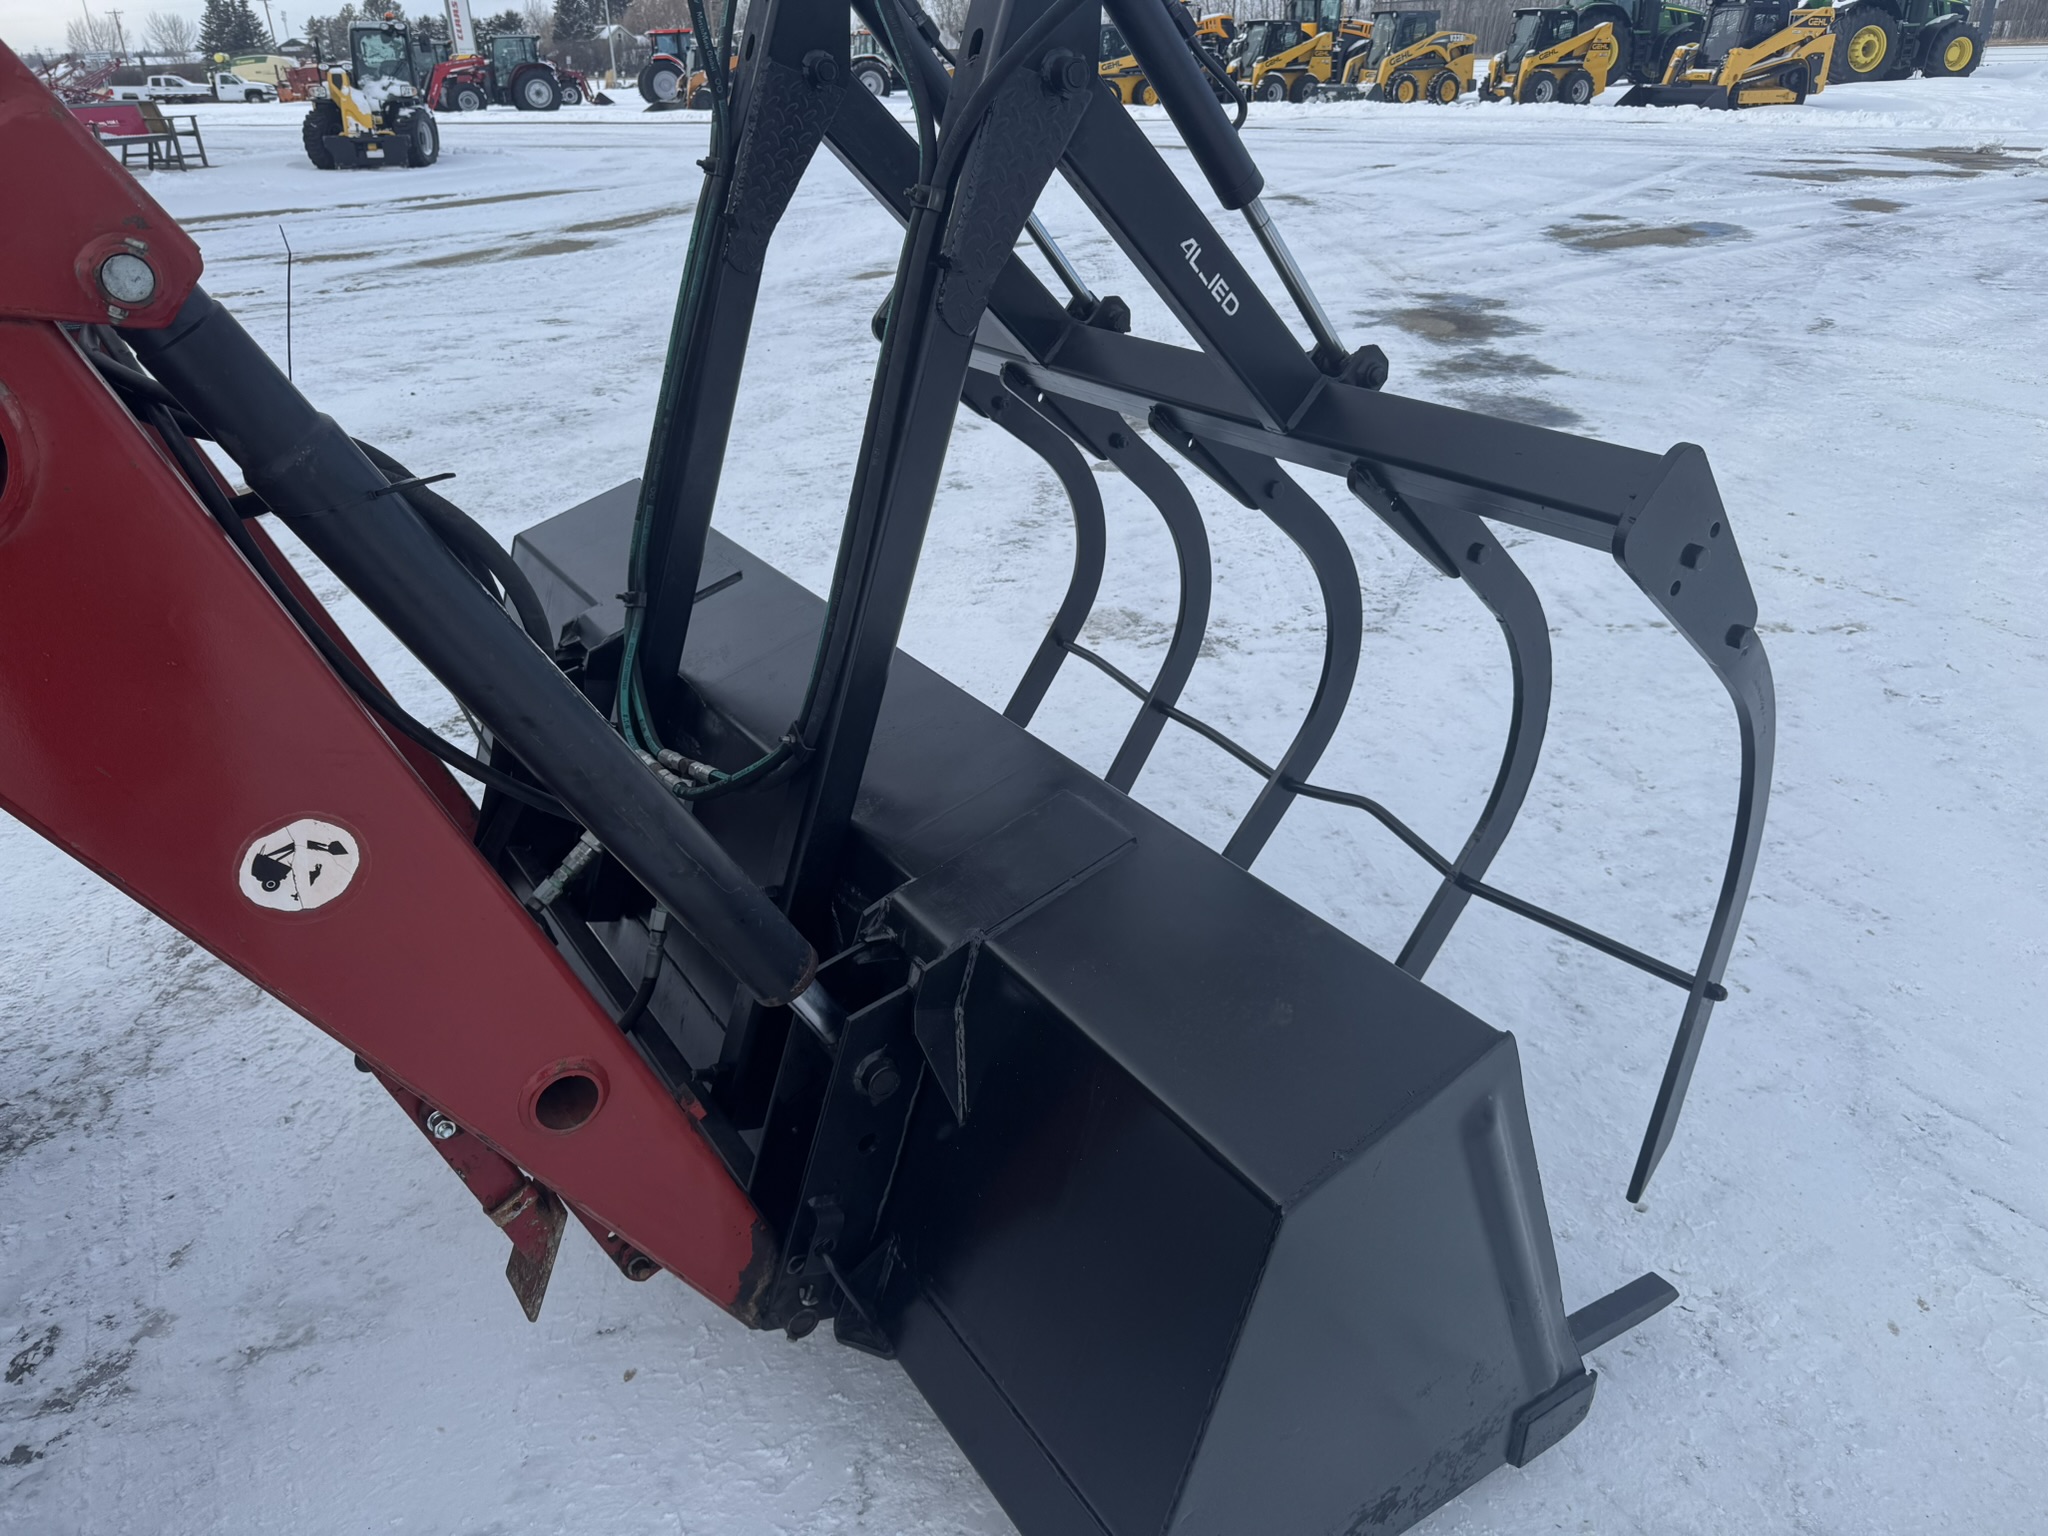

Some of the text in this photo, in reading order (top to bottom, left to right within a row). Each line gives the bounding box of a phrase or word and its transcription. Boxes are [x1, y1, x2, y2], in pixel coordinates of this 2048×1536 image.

[451, 1, 464, 41] CLAAS
[1808, 17, 1828, 26] GEHL
[1389, 51, 1413, 66] GEHL
[1538, 49, 1558, 61] GEHL
[1101, 60, 1123, 71] GEHL
[1264, 56, 1282, 68] GEHL
